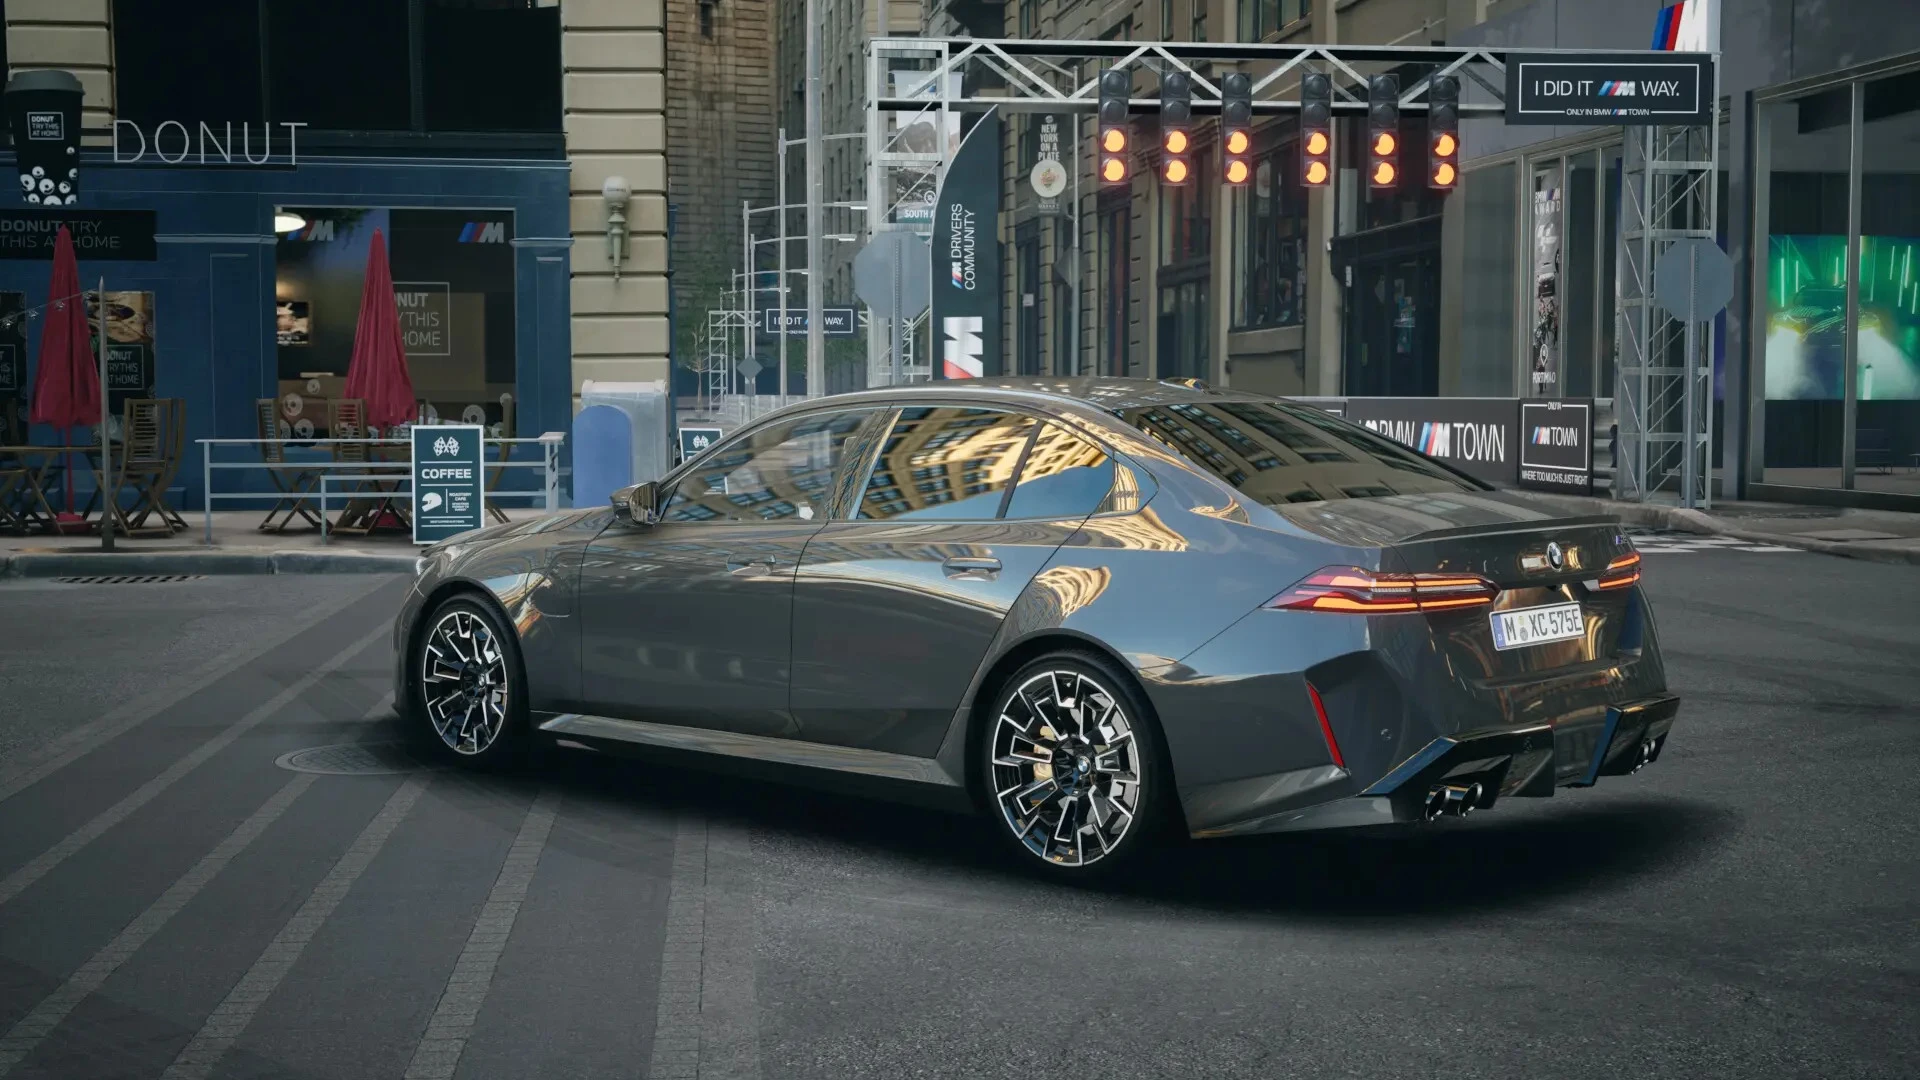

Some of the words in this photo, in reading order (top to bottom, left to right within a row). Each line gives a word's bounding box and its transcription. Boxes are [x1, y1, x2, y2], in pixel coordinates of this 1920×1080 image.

[1535, 81, 1539, 96] I
[1543, 81, 1573, 96] DID
[1577, 81, 1593, 96] IT
[1641, 81, 1680, 97] WAY.
[1041, 124, 1057, 133] NEW
[113, 120, 308, 166] DONUT
[1040, 133, 1058, 142] YORK
[1041, 143, 1051, 151] ON
[1052, 143, 1057, 151] A
[1038, 152, 1060, 160] PLATE
[904, 209, 929, 218] SOUTH
[1, 220, 63, 232] DONUT
[68, 221, 101, 232] TRY
[474, 222, 504, 243] M
[951, 203, 962, 258] DRIVERS
[0, 236, 37, 248] THIS
[71, 236, 121, 249] HOME
[964, 209, 976, 290] COMMUNITY
[396, 293, 428, 307] NUT
[409, 312, 439, 326] THIS
[795, 317, 802, 325] IT
[825, 317, 844, 325] WAY.
[120, 363, 138, 372] THIS
[116, 375, 139, 384] HOME
[1547, 402, 1556, 410] ONLY
[1453, 422, 1504, 462] TOWN
[1551, 427, 1578, 446] TOWN
[421, 468, 472, 479] COFFEE
[1522, 470, 1536, 481] WHERE
[1536, 471, 1546, 482] TOO
[1546, 471, 1559, 483] MUCH
[1563, 474, 1574, 485] JUST
[1574, 475, 1588, 486] RIGHT
[1504, 617, 1517, 641] M
[1529, 613, 1548, 638] XC
[1550, 608, 1582, 634] 575E
